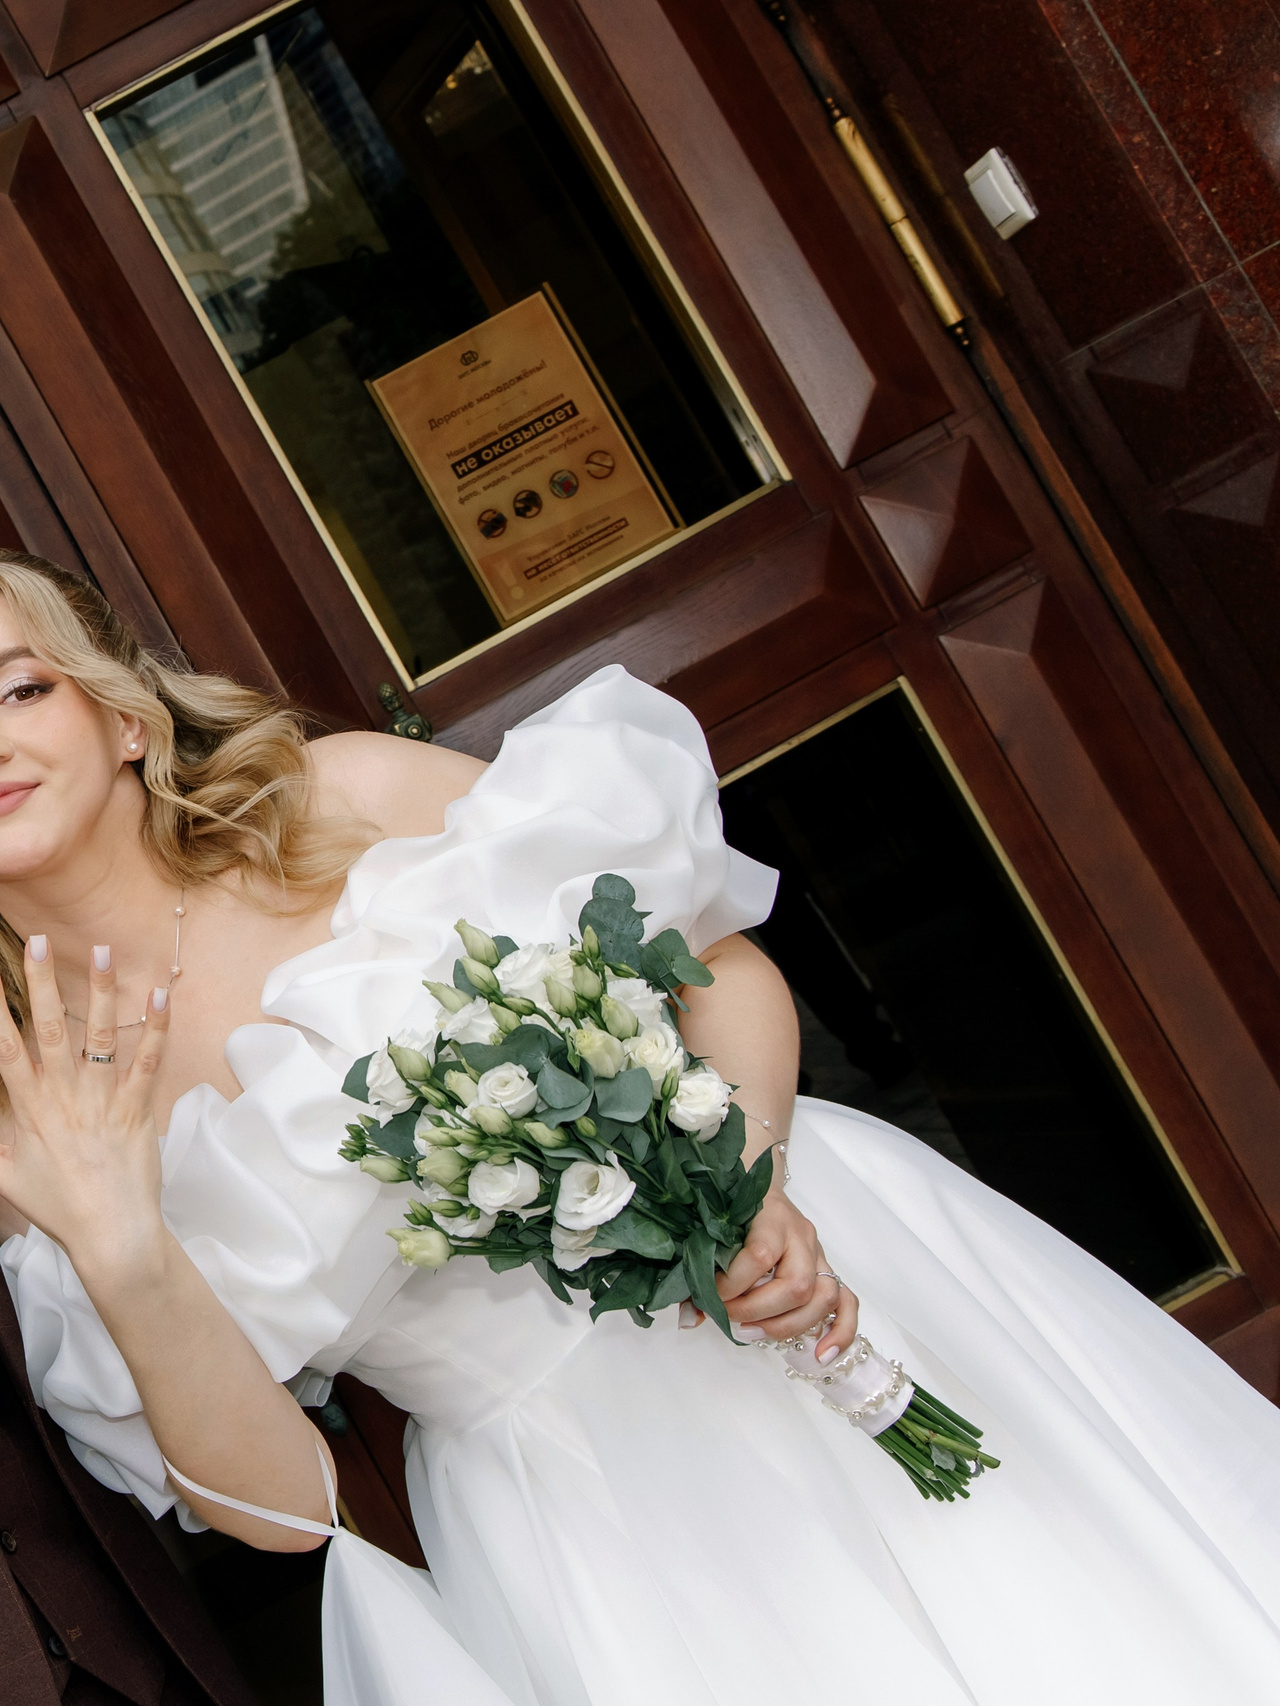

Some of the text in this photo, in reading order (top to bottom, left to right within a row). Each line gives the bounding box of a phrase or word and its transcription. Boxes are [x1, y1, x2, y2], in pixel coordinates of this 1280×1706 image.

[427, 360, 546, 432] Дорогие молодожёны!
[445, 446, 467, 459] Наш
[456, 405, 572, 475] не оказывает
